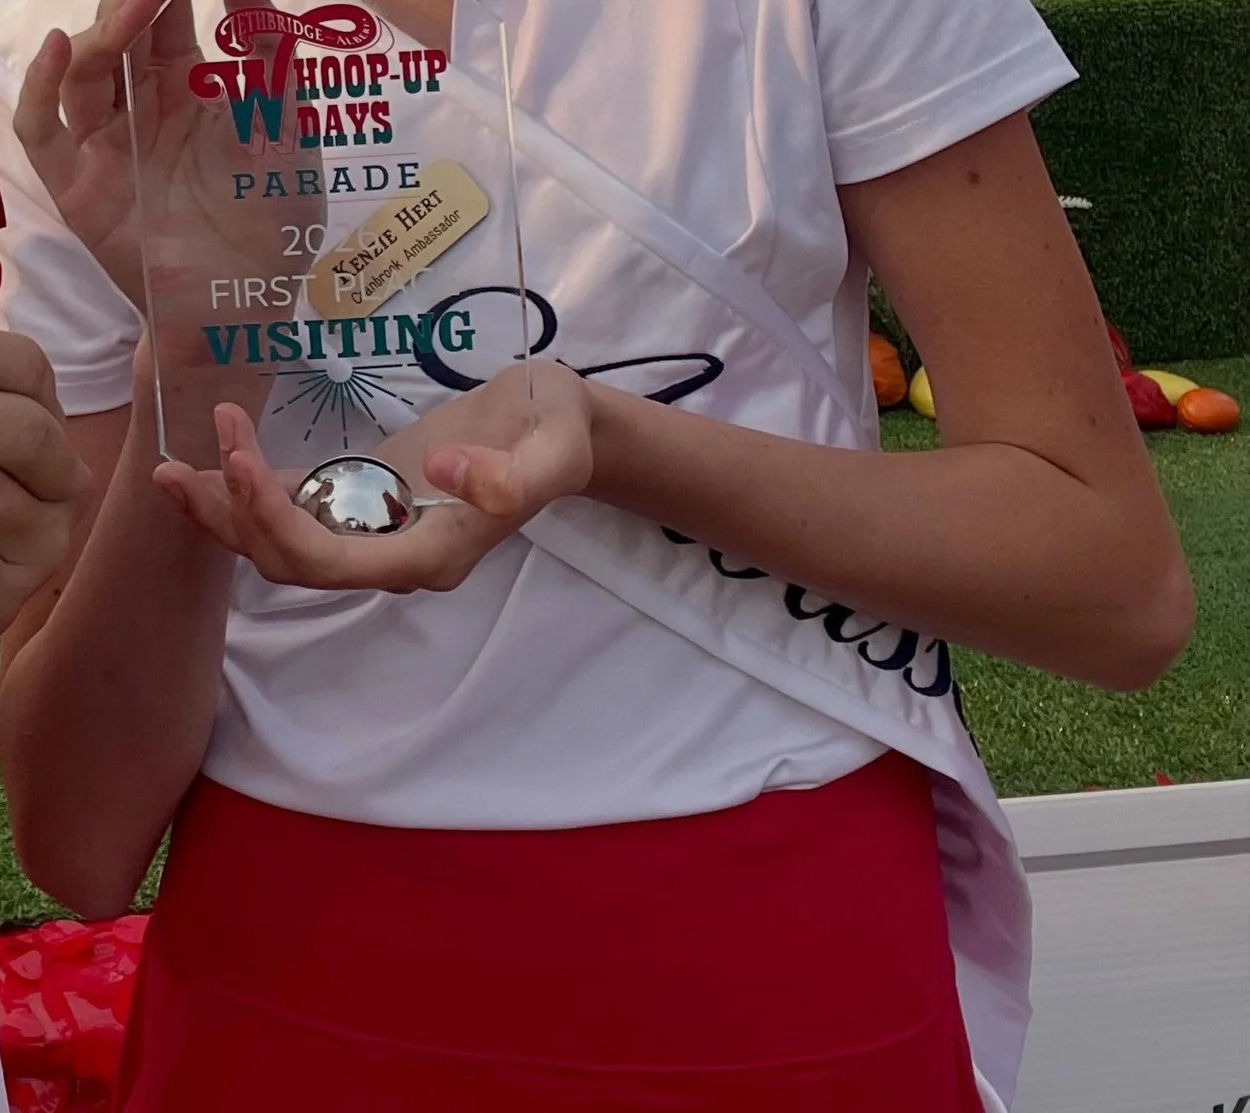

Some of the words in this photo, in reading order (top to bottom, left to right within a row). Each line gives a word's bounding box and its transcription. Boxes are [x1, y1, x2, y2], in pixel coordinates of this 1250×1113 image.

[220, 10, 324, 52] LETHBRIDGE
[188, 49, 447, 147] WHOOP-UP
[296, 100, 393, 149] DAYS
[232, 162, 421, 200] PARADE
[394, 189, 444, 233] HERT
[403, 208, 462, 263] Ambassador
[210, 274, 317, 310] FIRST
[201, 310, 476, 366] VISITING
